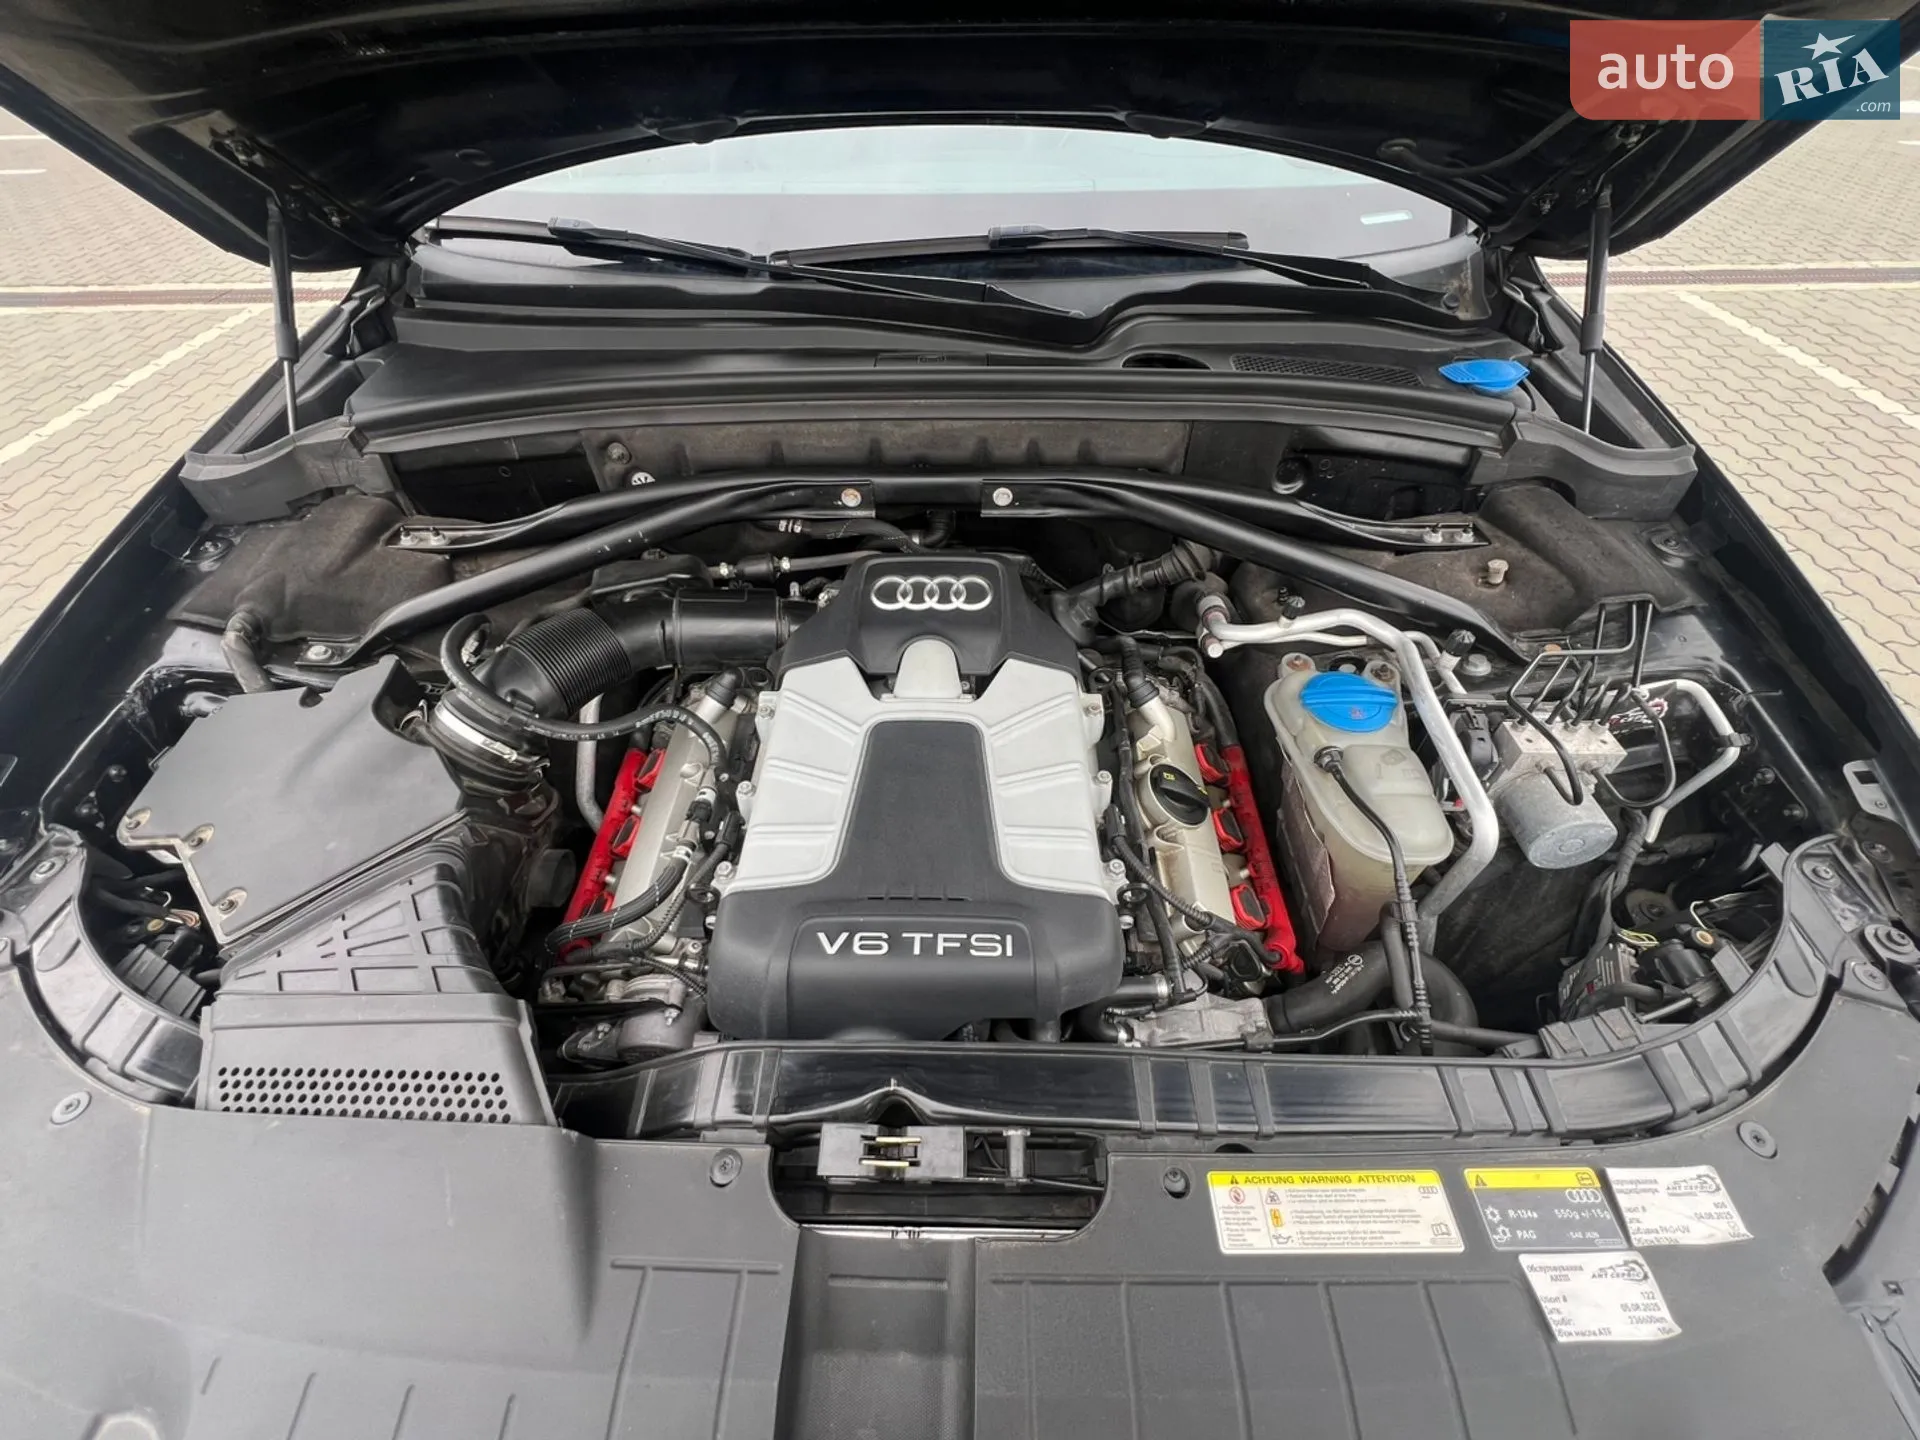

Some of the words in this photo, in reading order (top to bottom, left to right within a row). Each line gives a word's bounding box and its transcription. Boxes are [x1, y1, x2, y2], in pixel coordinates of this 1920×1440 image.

[816, 931, 889, 956] V6
[901, 932, 1014, 957] TFSI
[1244, 1175, 1295, 1184] ACHTUNG
[1299, 1174, 1352, 1184] WARNING
[1358, 1174, 1416, 1184] ATTENTION
[1516, 1230, 1537, 1239] PAG
[1640, 1291, 1656, 1300] 122
